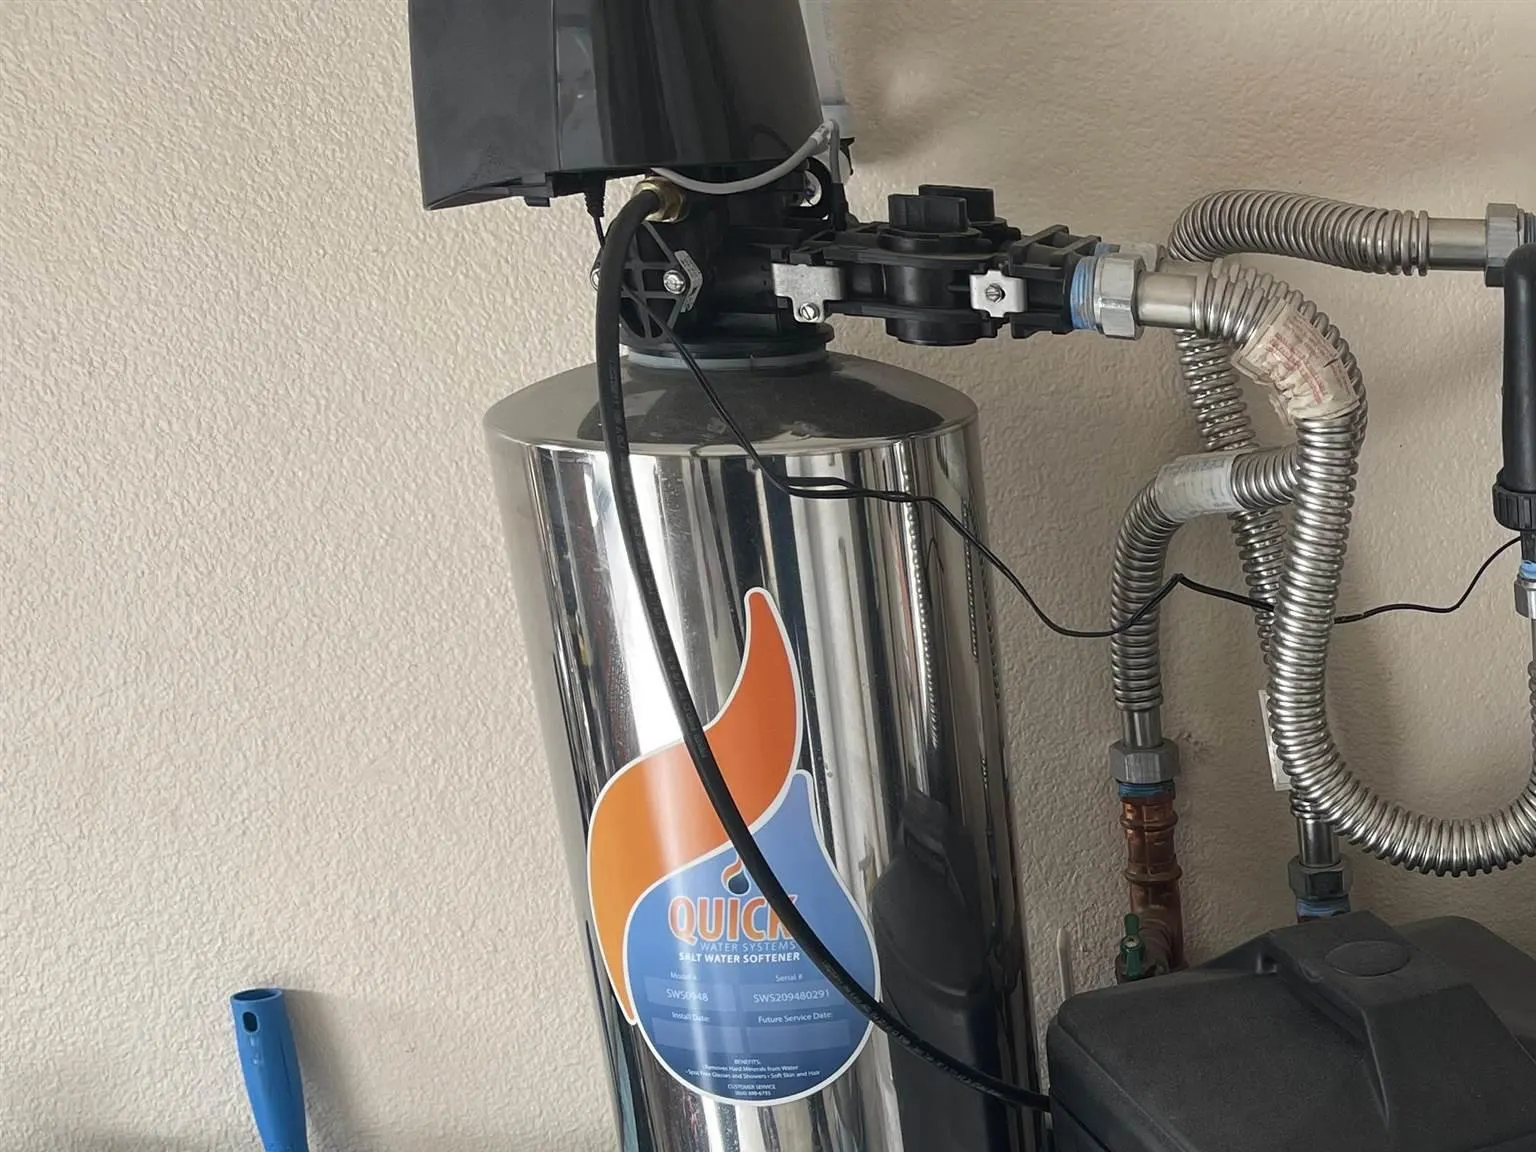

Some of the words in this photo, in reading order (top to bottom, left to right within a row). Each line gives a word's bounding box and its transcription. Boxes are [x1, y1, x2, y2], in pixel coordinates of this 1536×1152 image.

[701, 941, 738, 952] WATER
[742, 940, 797, 951] SYSTEMS
[679, 951, 702, 962] SALT
[704, 952, 740, 963] WATER
[743, 952, 800, 963] SOFTENER
[775, 973, 797, 983] Serial
[753, 988, 830, 1004] SWS209480291
[671, 1011, 690, 1020] Install
[758, 1015, 783, 1024] Future
[785, 1013, 810, 1023] Service
